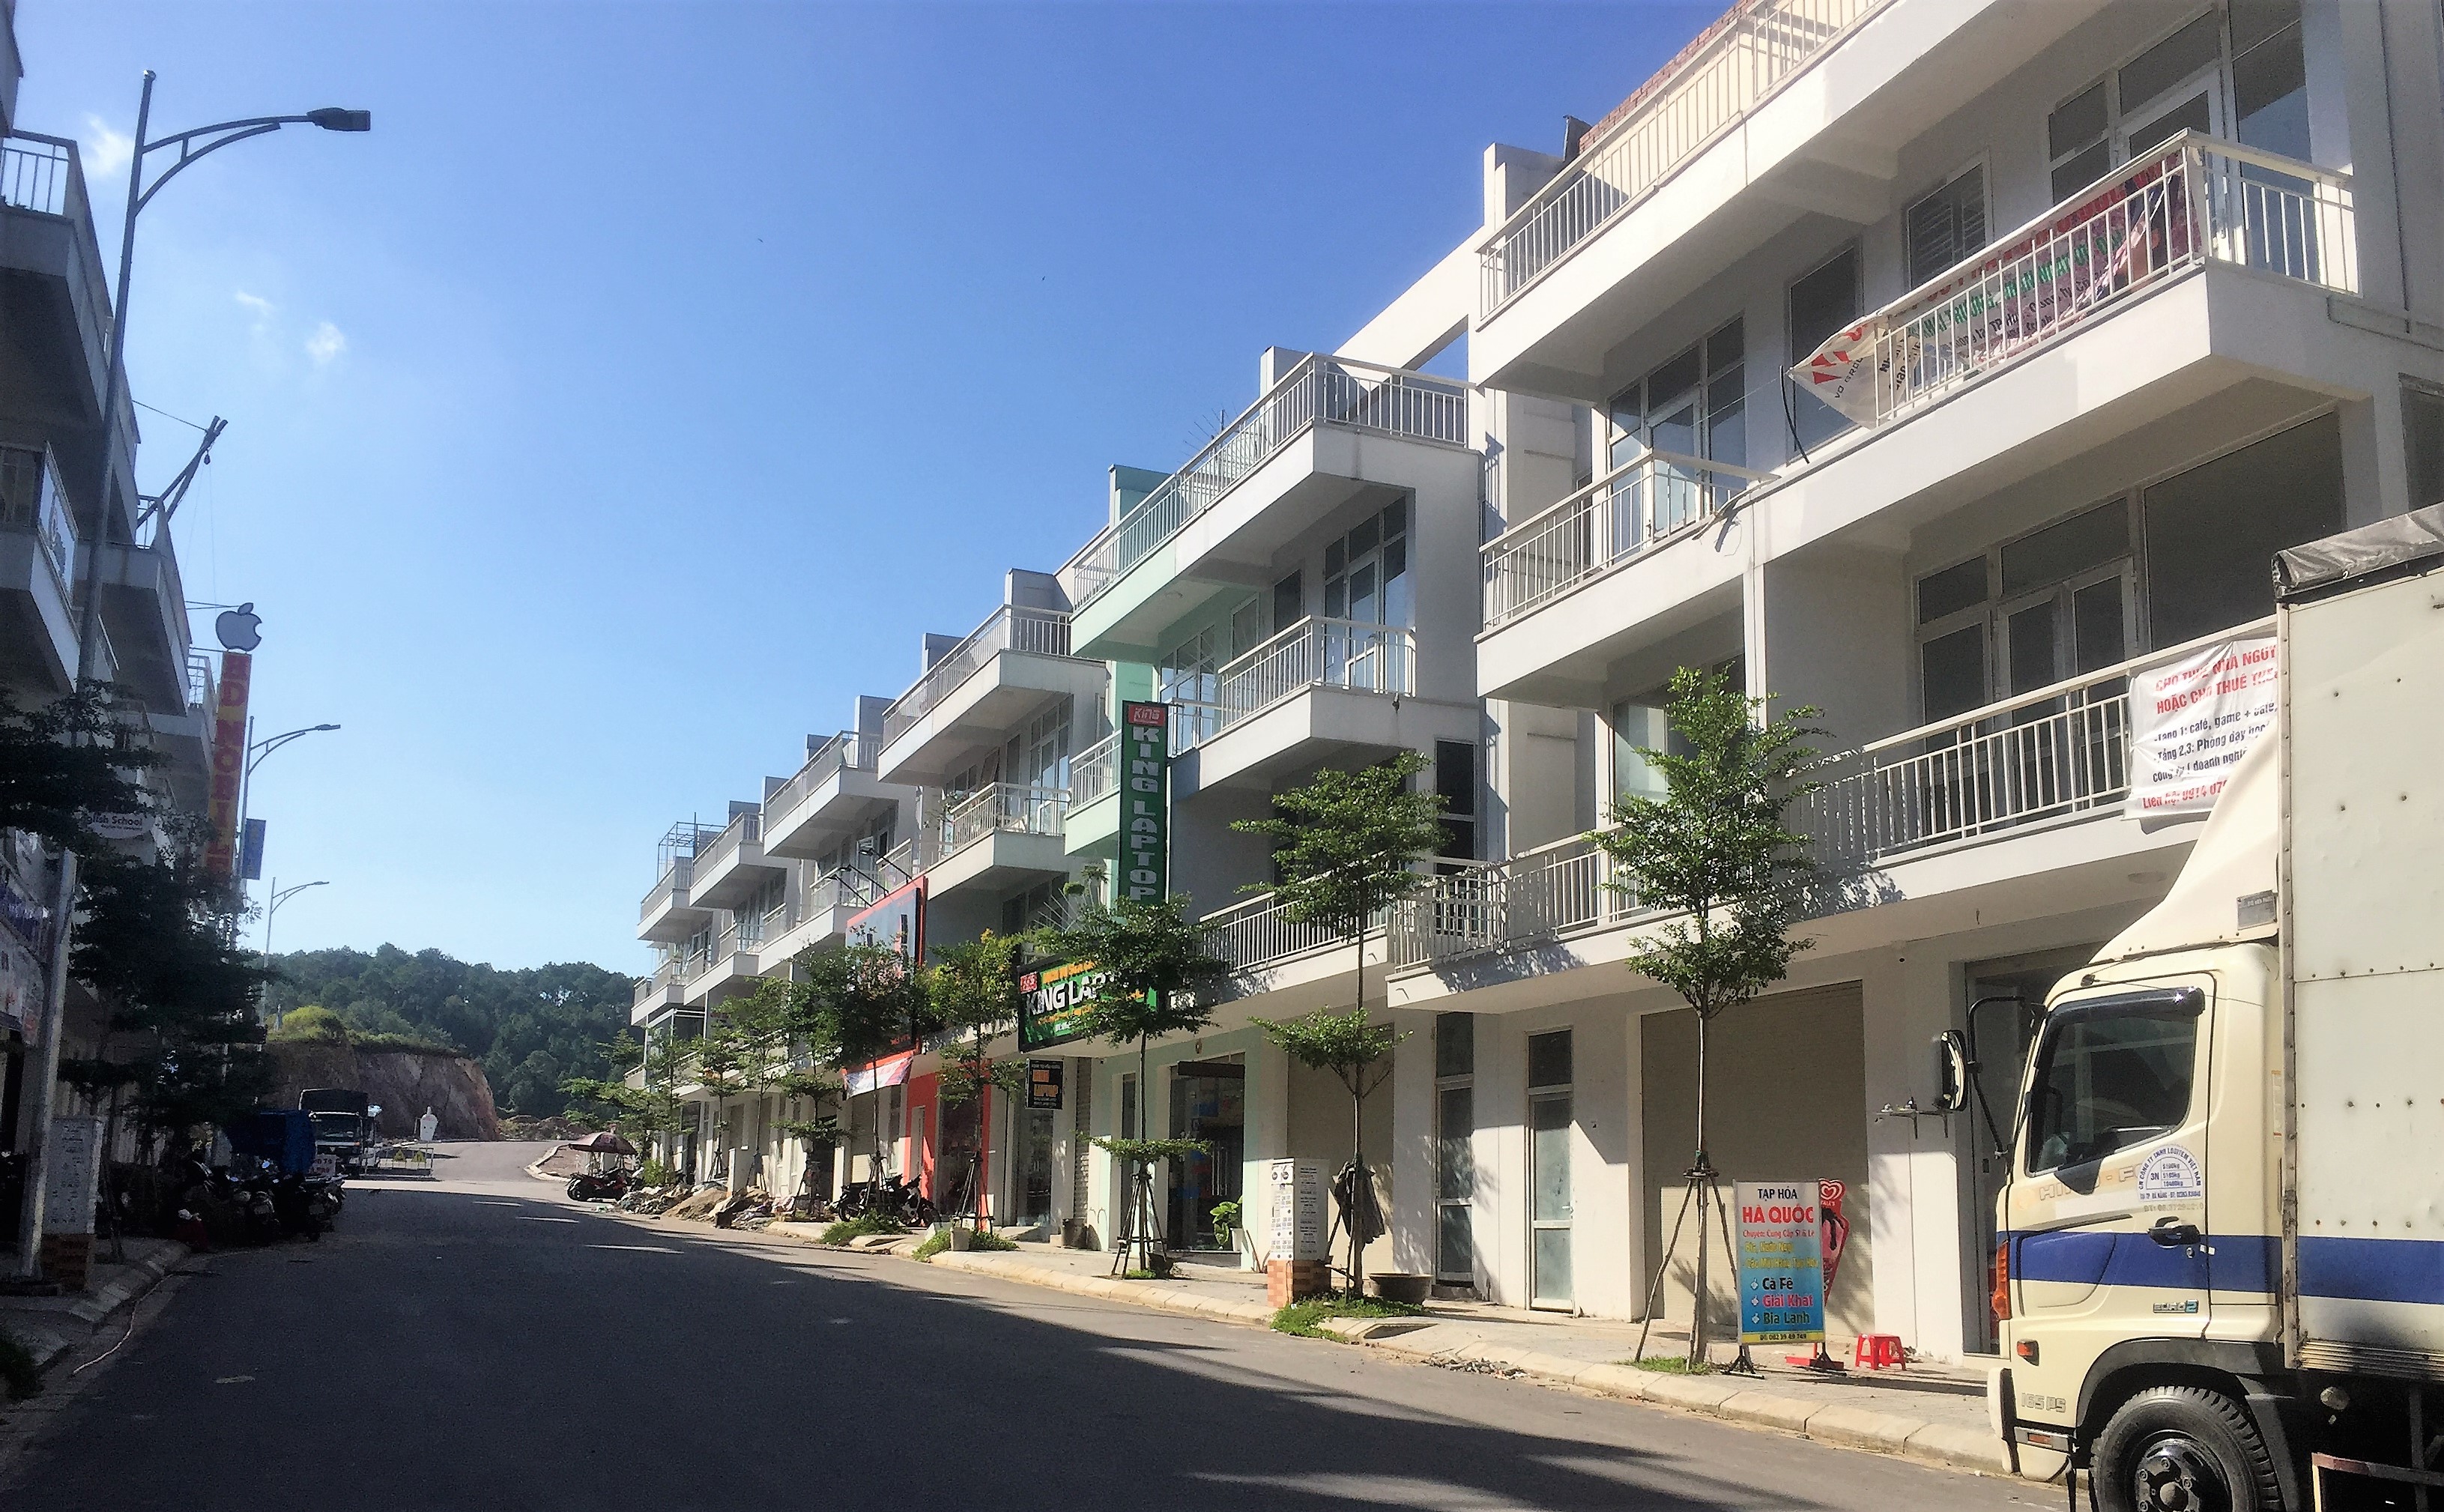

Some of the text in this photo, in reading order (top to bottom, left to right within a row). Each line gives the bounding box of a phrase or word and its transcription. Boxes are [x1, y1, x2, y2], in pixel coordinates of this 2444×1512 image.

[2215, 673, 2247, 695] THUÊ
[2215, 711, 2241, 728] game
[1131, 726, 1160, 793] KING
[2193, 755, 2220, 772] doanh
[112, 816, 142, 826] School
[1129, 799, 1158, 901] LAPTOP
[1026, 982, 1067, 1016] KING
[1758, 1188, 1775, 1201] TẠP
[1762, 1276, 1794, 1290] Cà Fê
[1763, 1311, 1780, 1325] Bia
[2021, 1393, 2066, 1413] 165 PS
